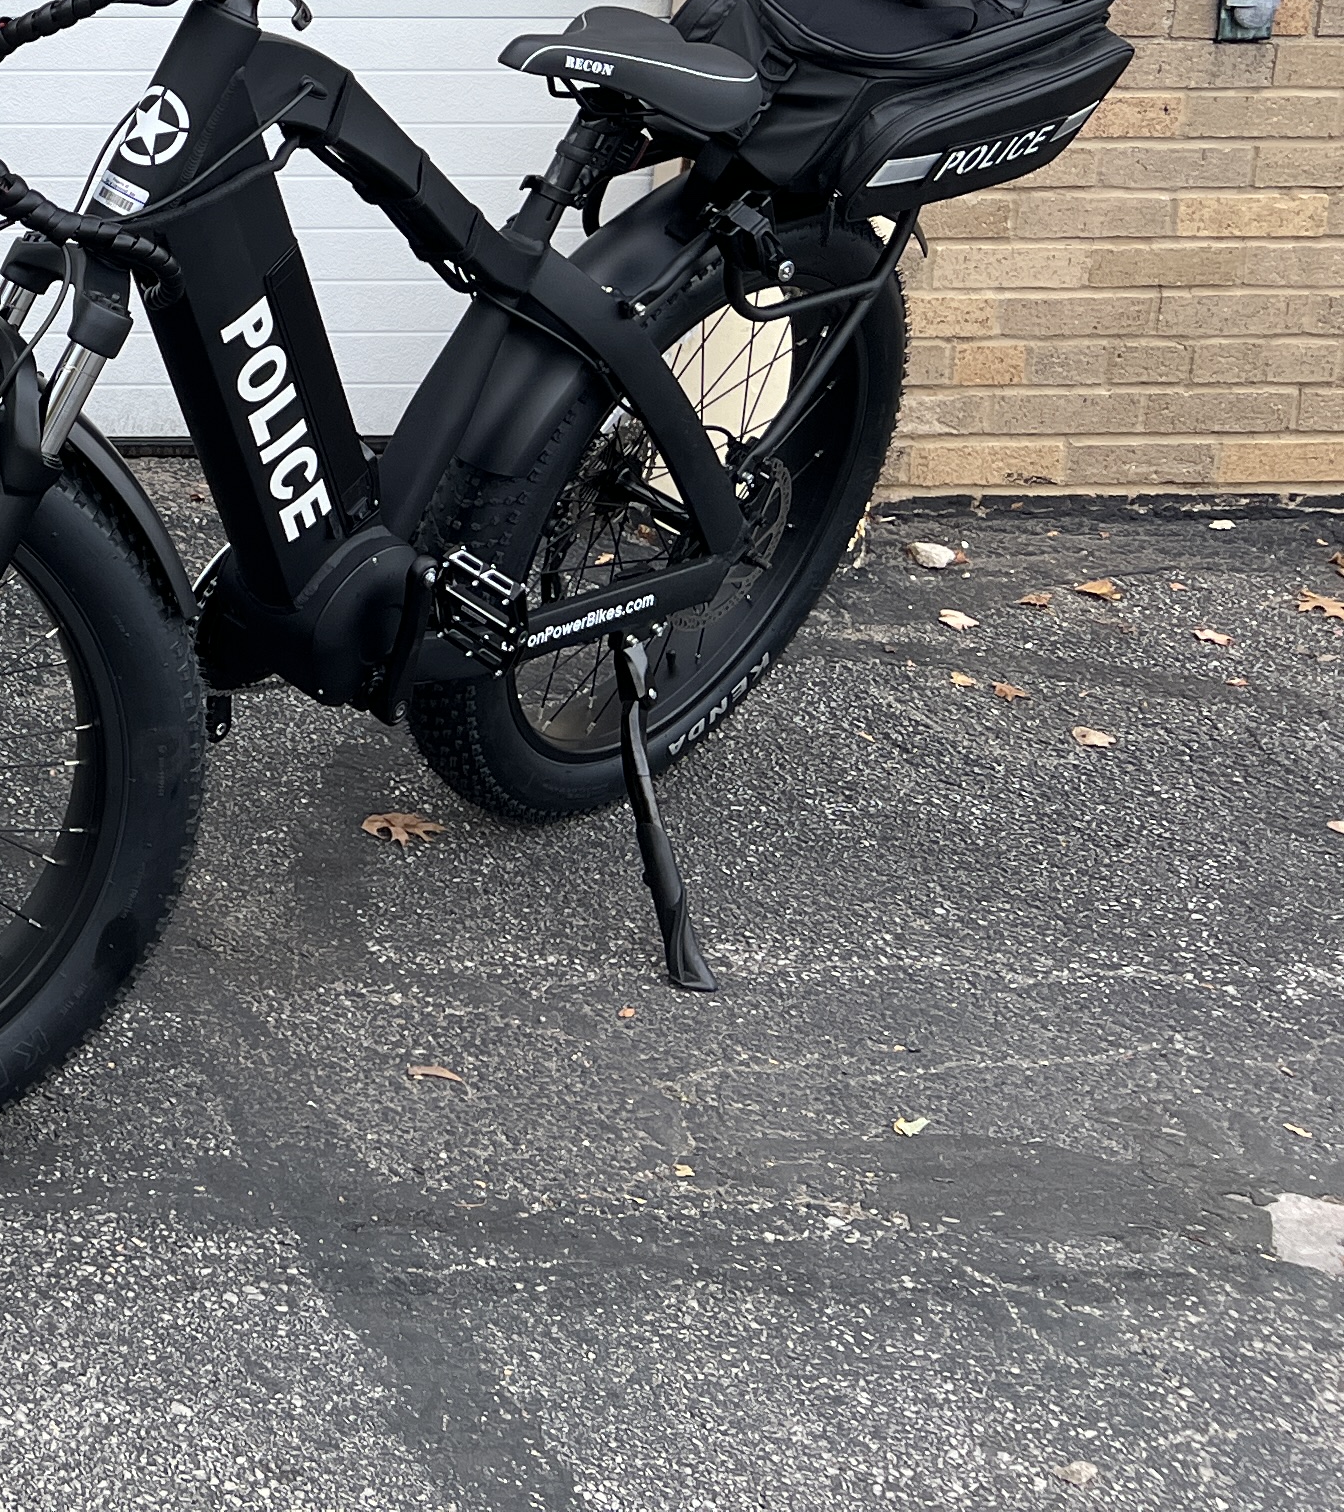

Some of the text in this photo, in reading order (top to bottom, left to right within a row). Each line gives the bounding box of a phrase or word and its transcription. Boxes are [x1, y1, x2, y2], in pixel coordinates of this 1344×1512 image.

[565, 55, 615, 76] RECON
[933, 124, 1055, 181] POLICE
[220, 295, 332, 543] POLICE
[527, 593, 655, 648] onPowerBikes.com
[669, 652, 770, 755] KENDA
